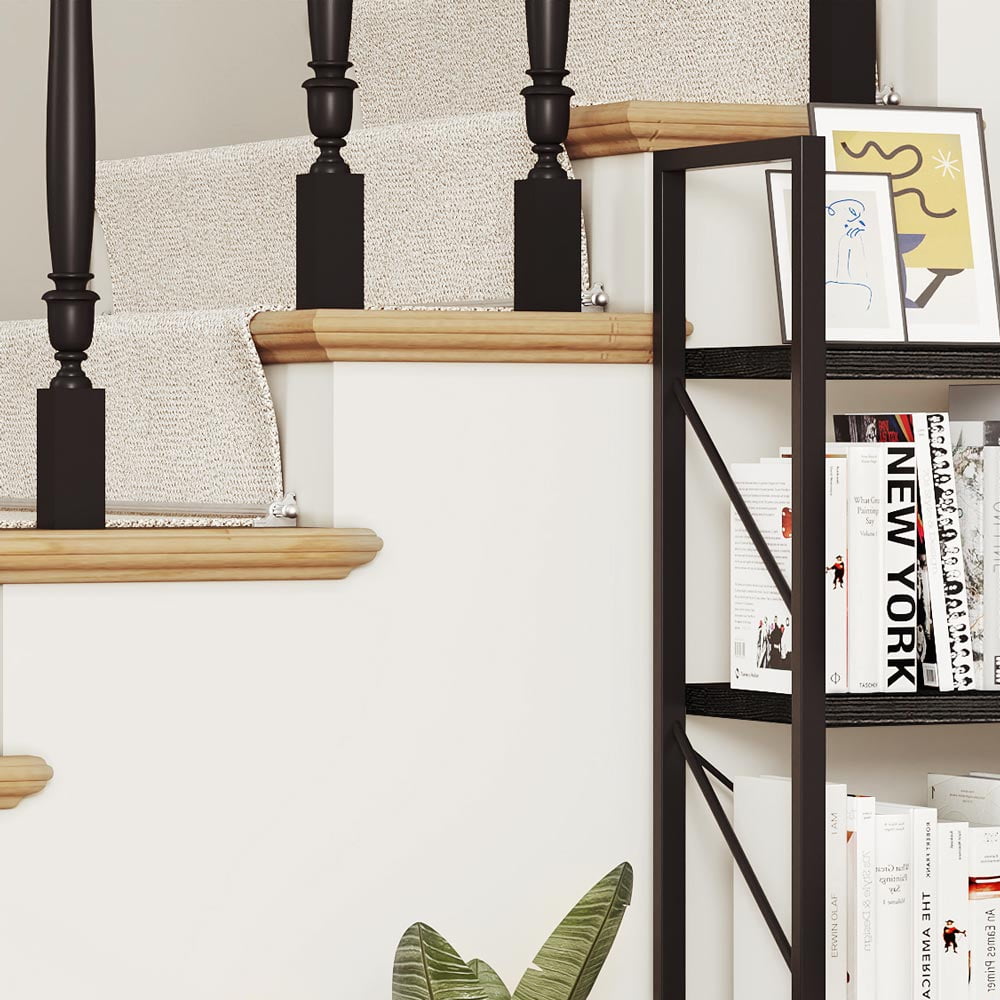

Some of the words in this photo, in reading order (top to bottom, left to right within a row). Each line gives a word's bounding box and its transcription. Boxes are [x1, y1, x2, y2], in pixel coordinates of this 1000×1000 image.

[887, 447, 915, 547] NEW
[887, 563, 916, 688] YORK
[831, 895, 839, 921] OLAF
[831, 923, 839, 958] ERWIN
